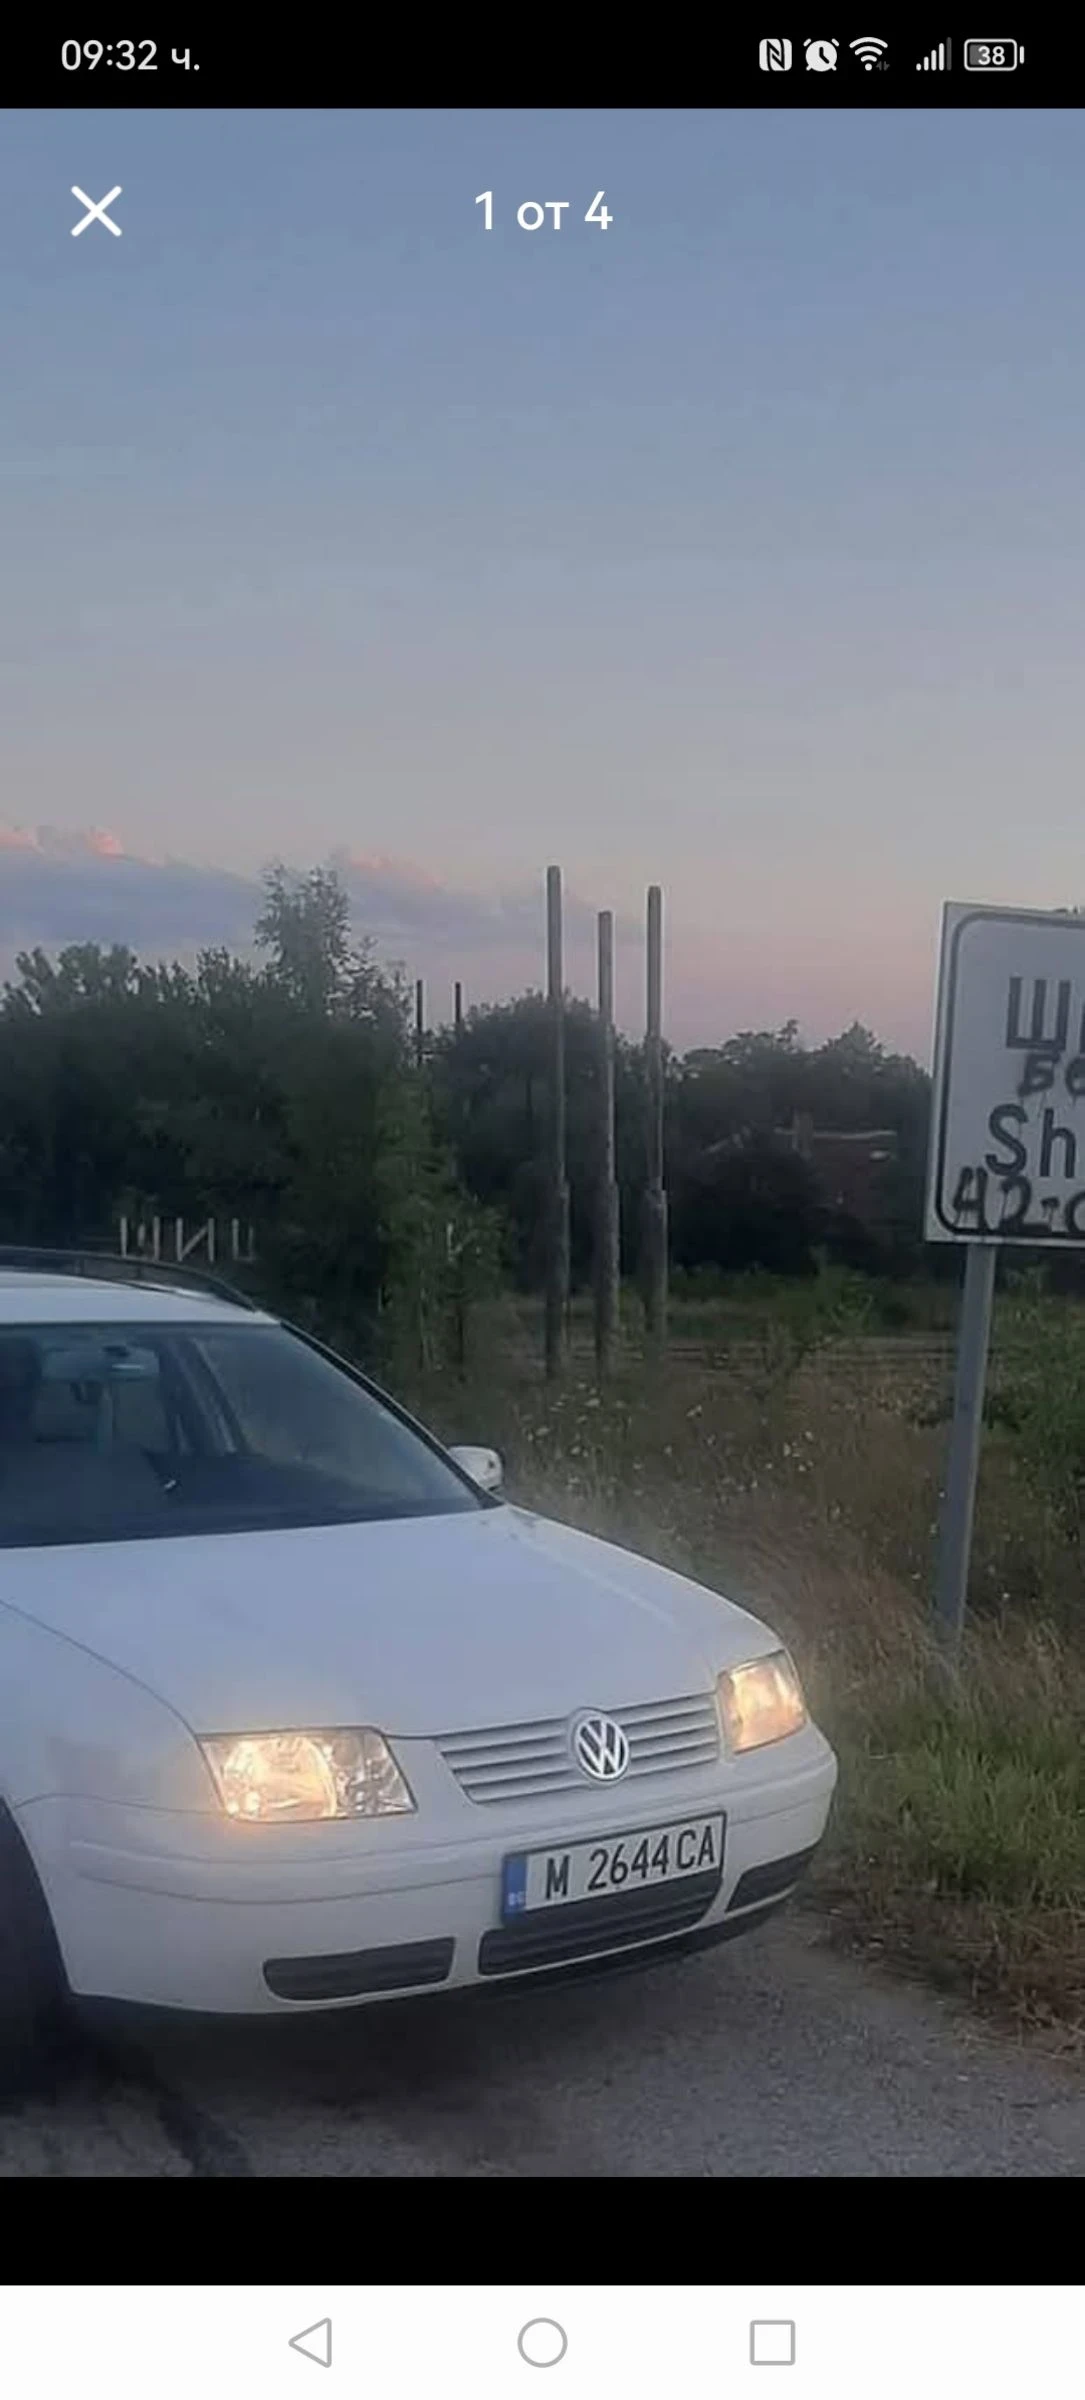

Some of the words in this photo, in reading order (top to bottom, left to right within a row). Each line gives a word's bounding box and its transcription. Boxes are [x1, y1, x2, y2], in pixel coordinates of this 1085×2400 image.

[1006, 976, 1085, 1053] Ш
[575, 1716, 630, 1782] VW
[545, 1855, 571, 1899] M
[588, 1834, 669, 1891] 2644
[677, 1825, 715, 1869] CA
